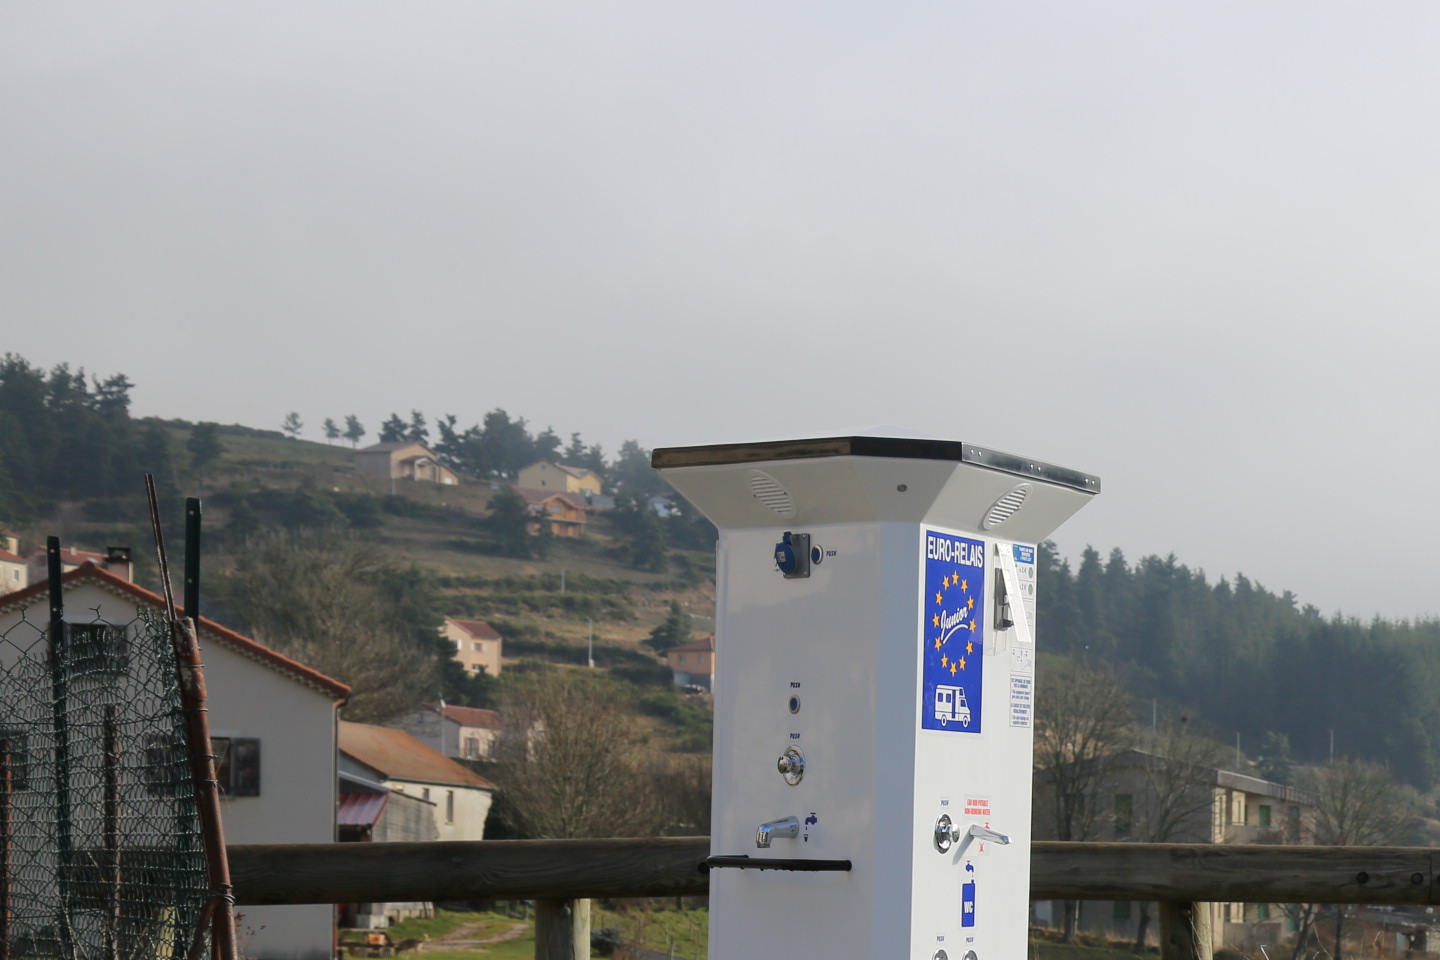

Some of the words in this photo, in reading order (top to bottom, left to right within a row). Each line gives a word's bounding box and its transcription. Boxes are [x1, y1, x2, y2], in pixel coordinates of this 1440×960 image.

[927, 535, 983, 568] EURO-RELAIS
[940, 606, 969, 640] Junior
[963, 901, 974, 914] WC
